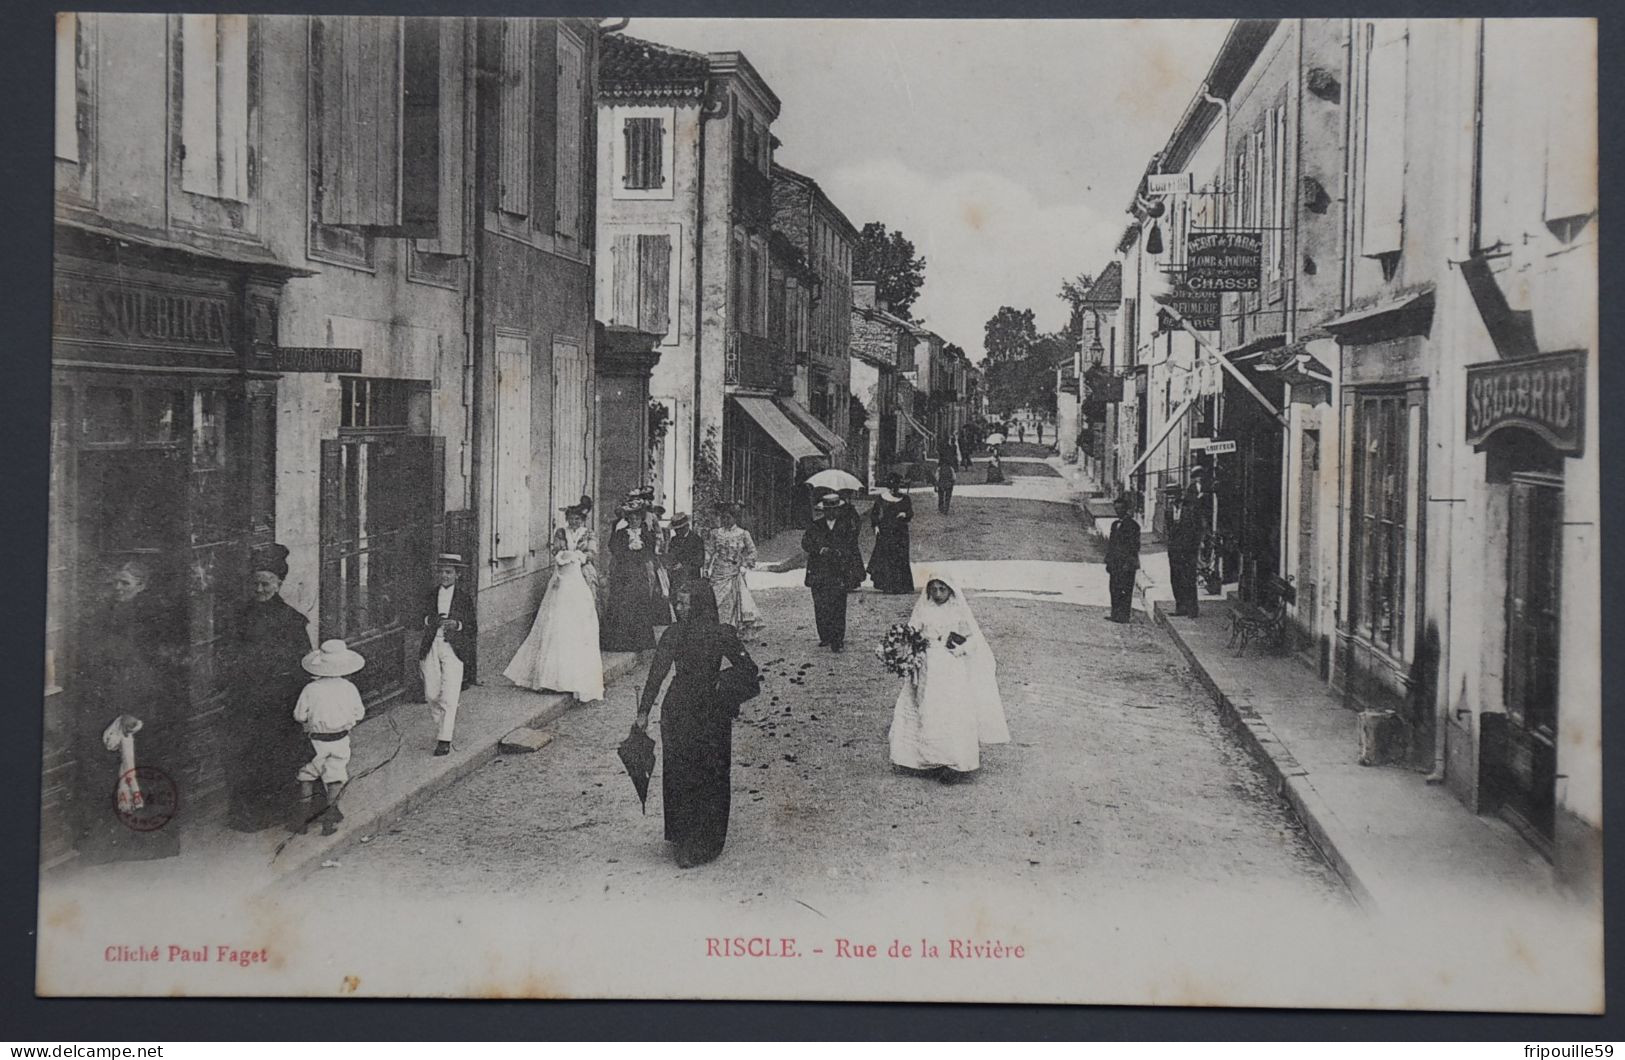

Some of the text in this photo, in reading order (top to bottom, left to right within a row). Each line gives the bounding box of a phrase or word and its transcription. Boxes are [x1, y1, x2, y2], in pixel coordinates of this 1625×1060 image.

[1226, 234, 1262, 253] TABAC
[1188, 256, 1217, 267] PLOMB
[1225, 256, 1260, 267] POUDRE
[1187, 277, 1258, 289] CHASSE
[1472, 367, 1571, 432] SELLERIE
